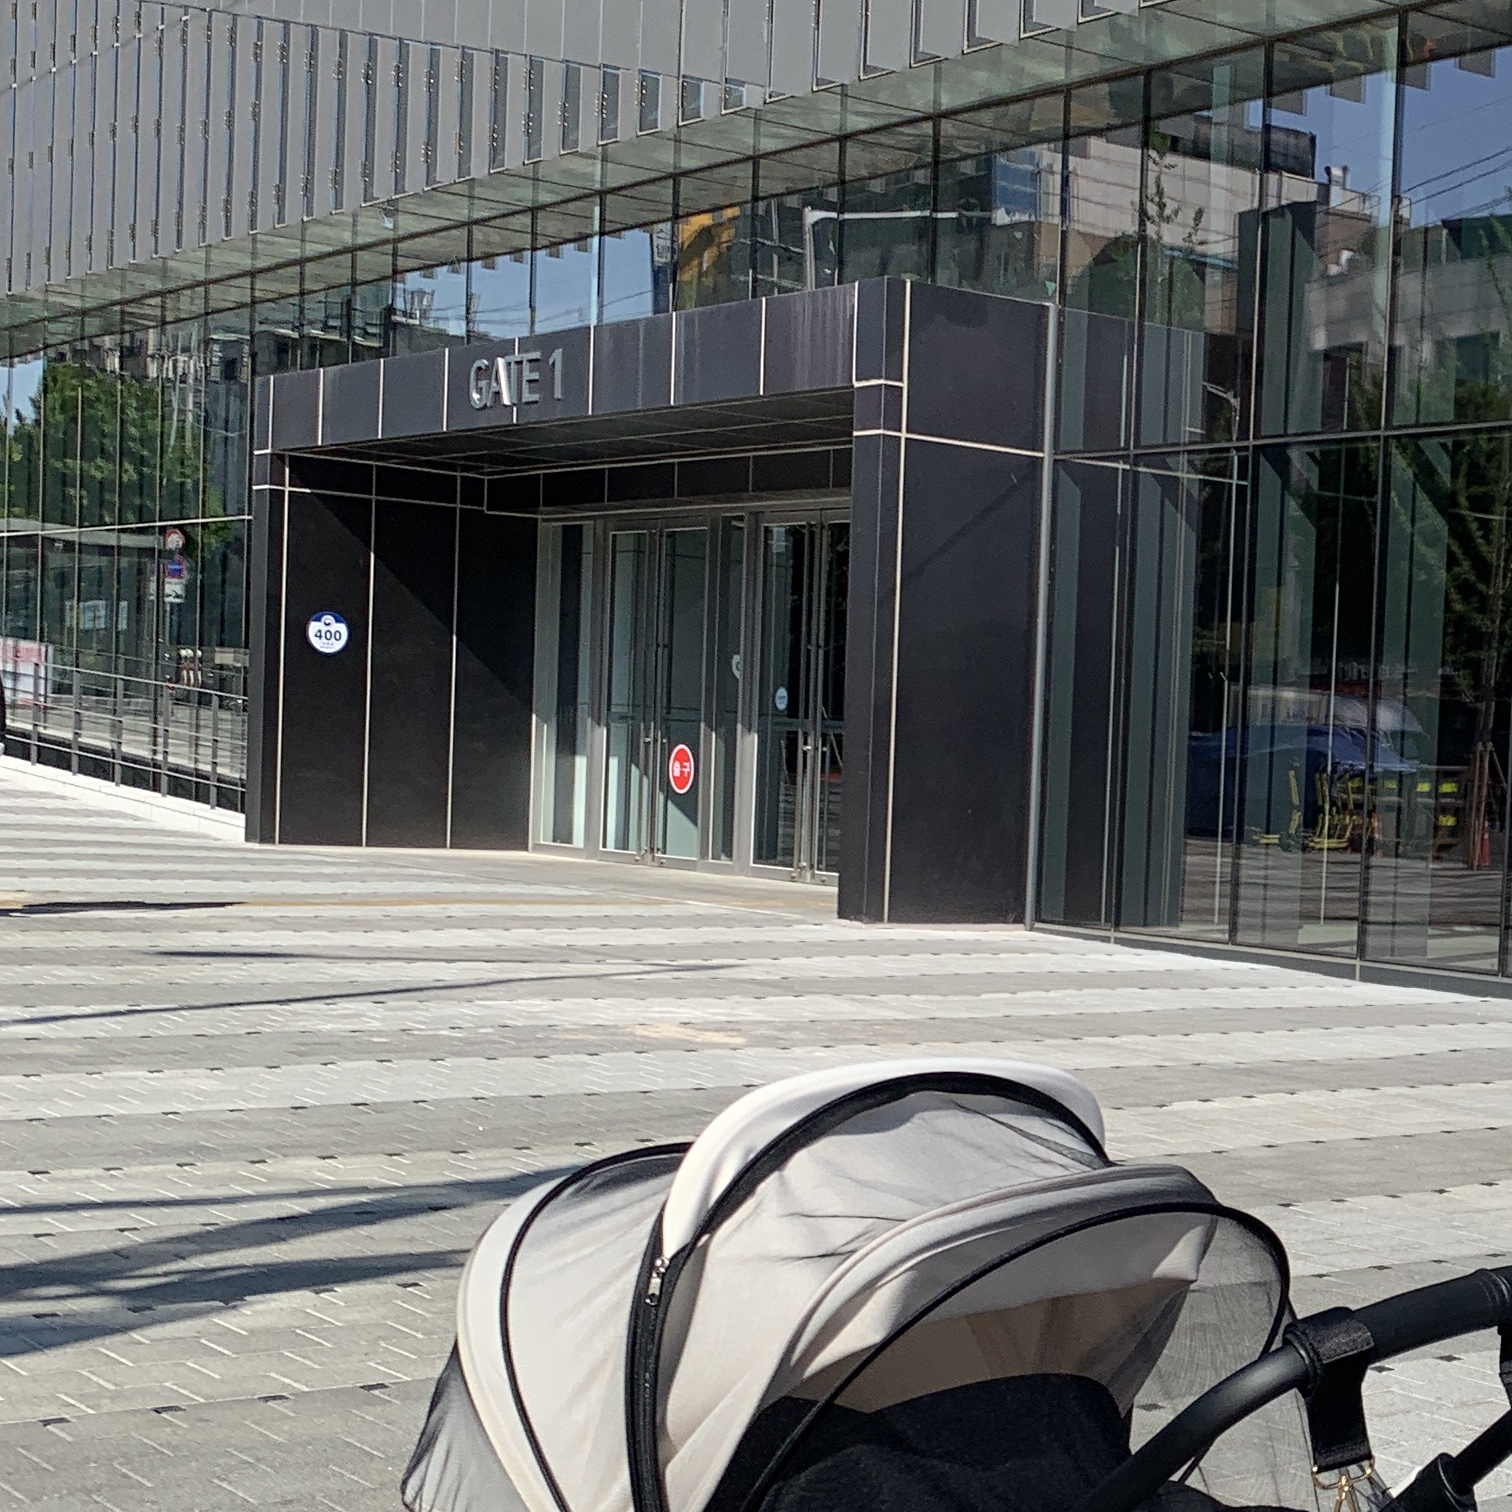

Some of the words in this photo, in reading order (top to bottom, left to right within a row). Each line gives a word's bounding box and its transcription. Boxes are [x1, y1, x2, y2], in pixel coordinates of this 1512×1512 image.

[469, 351, 542, 410] GATE
[548, 348, 563, 400] 1
[314, 629, 342, 642] 400
